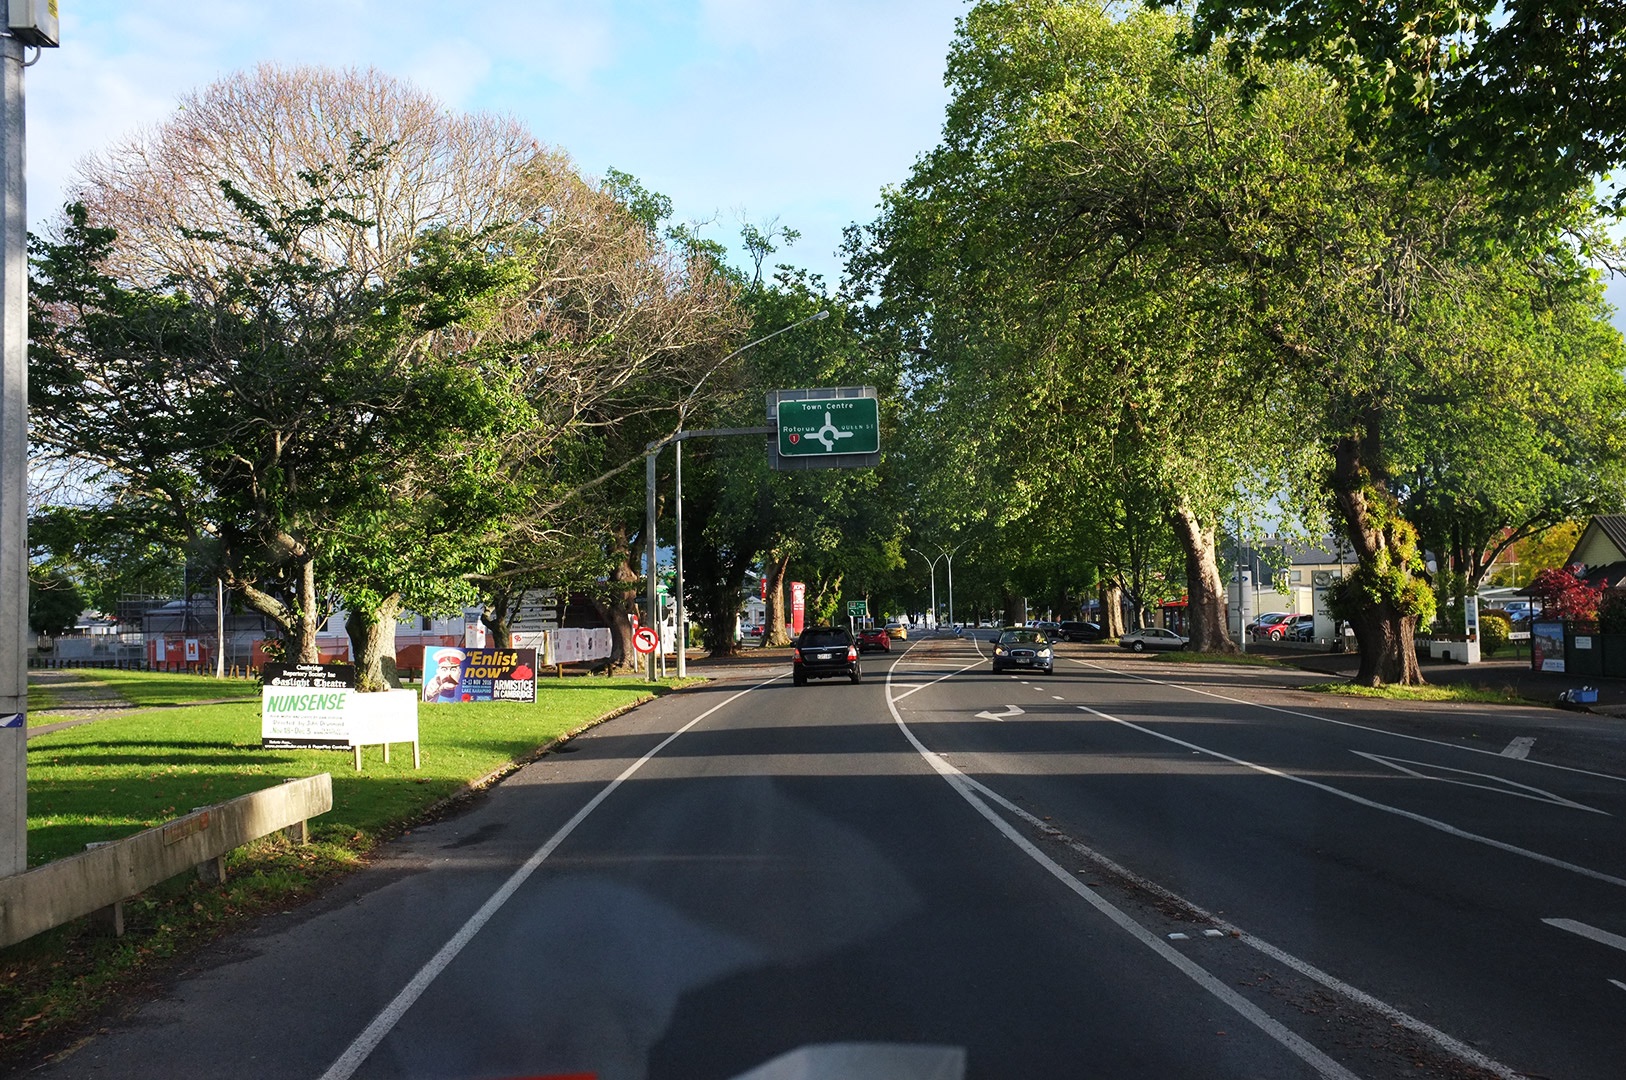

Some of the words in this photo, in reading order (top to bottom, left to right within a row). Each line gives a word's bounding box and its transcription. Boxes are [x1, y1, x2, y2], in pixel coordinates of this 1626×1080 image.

[802, 403, 822, 411] Town
[826, 402, 853, 410] Centre
[188, 643, 196, 655] H
[296, 664, 324, 672] Cambridge
[283, 670, 308, 678] Repertory
[271, 677, 310, 687] Gaslight
[313, 678, 347, 688] Theatre
[494, 680, 534, 691] ARMISTICE
[493, 690, 500, 698] IN
[500, 690, 534, 698] CAMBRIDGE
[267, 693, 347, 712] NUNSENSE
